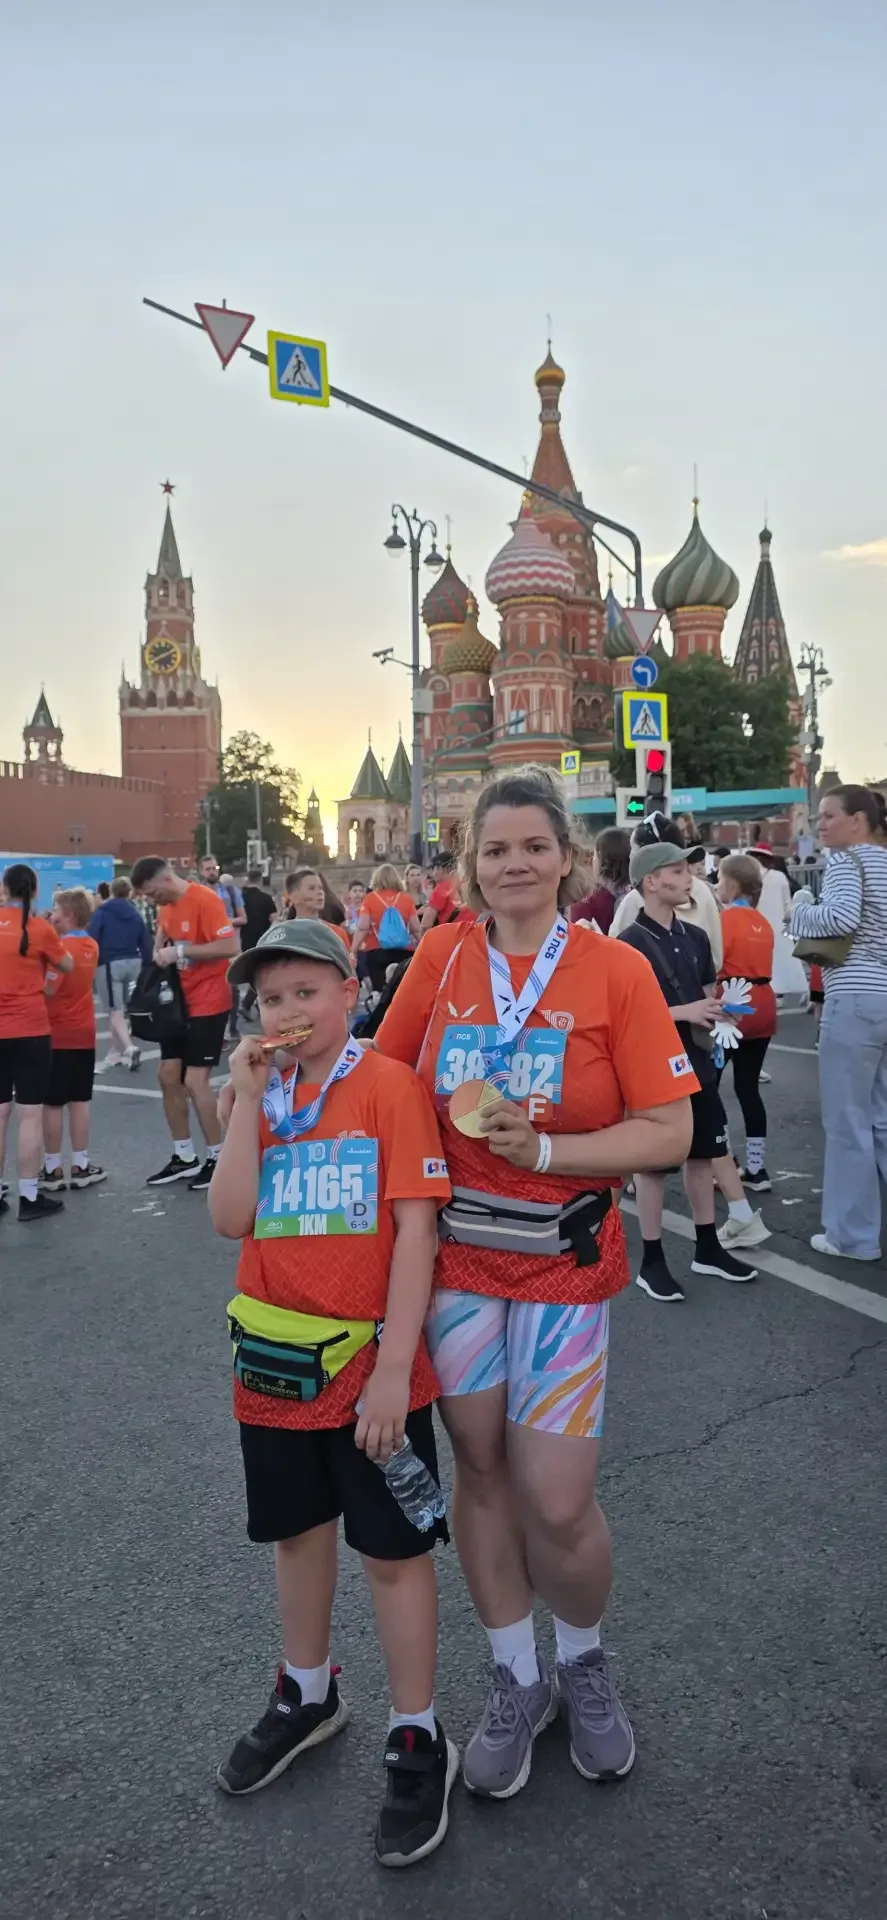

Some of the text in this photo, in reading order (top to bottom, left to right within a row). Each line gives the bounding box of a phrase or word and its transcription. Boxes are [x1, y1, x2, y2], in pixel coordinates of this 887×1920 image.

[442, 1047, 555, 1099] 3882
[528, 1097, 547, 1121] F
[271, 1164, 363, 1213] 14165
[353, 1202, 368, 1217] D
[298, 1213, 328, 1236] 1KM
[350, 1220, 368, 1229] 6-9
